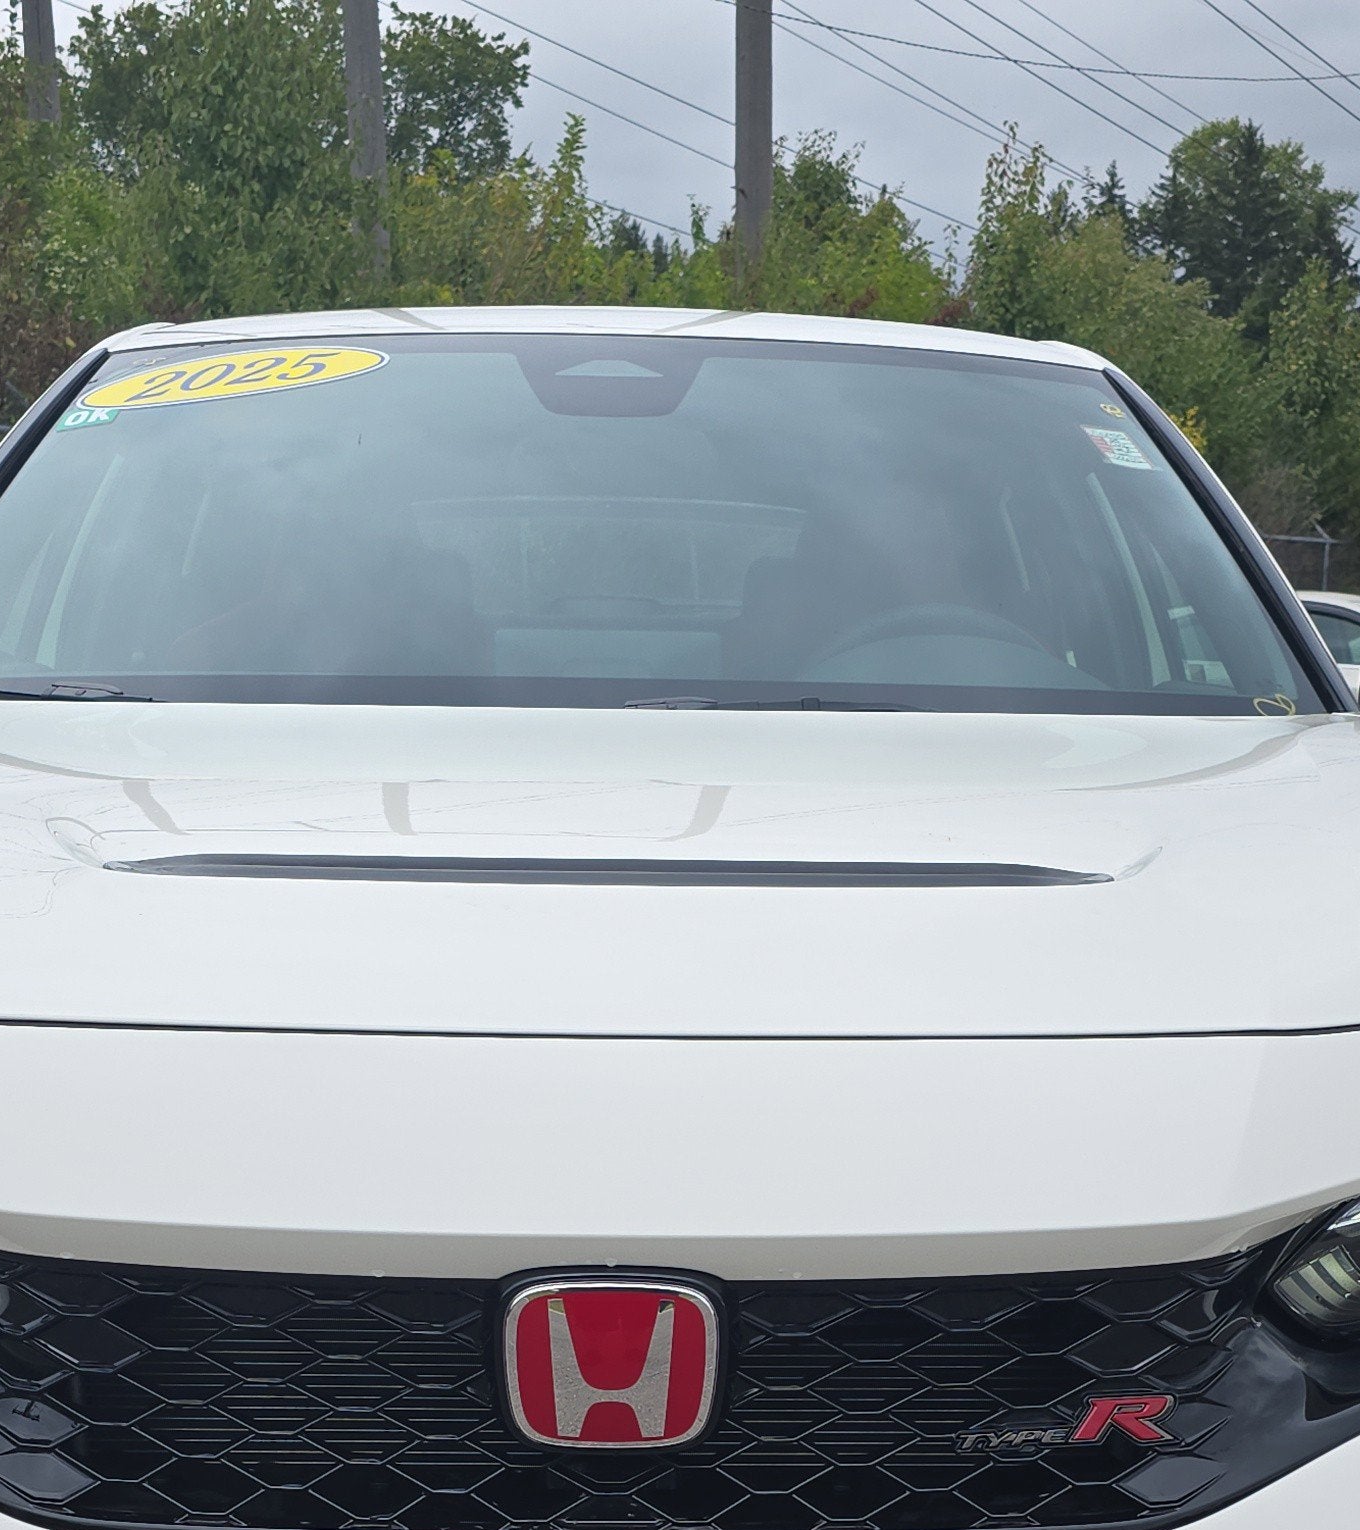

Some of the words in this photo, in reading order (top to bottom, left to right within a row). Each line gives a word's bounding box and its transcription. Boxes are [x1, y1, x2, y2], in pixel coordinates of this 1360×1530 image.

[124, 352, 341, 403] 2025
[64, 408, 111, 427] OK
[547, 1298, 674, 1438] H
[1069, 1395, 1175, 1443] R
